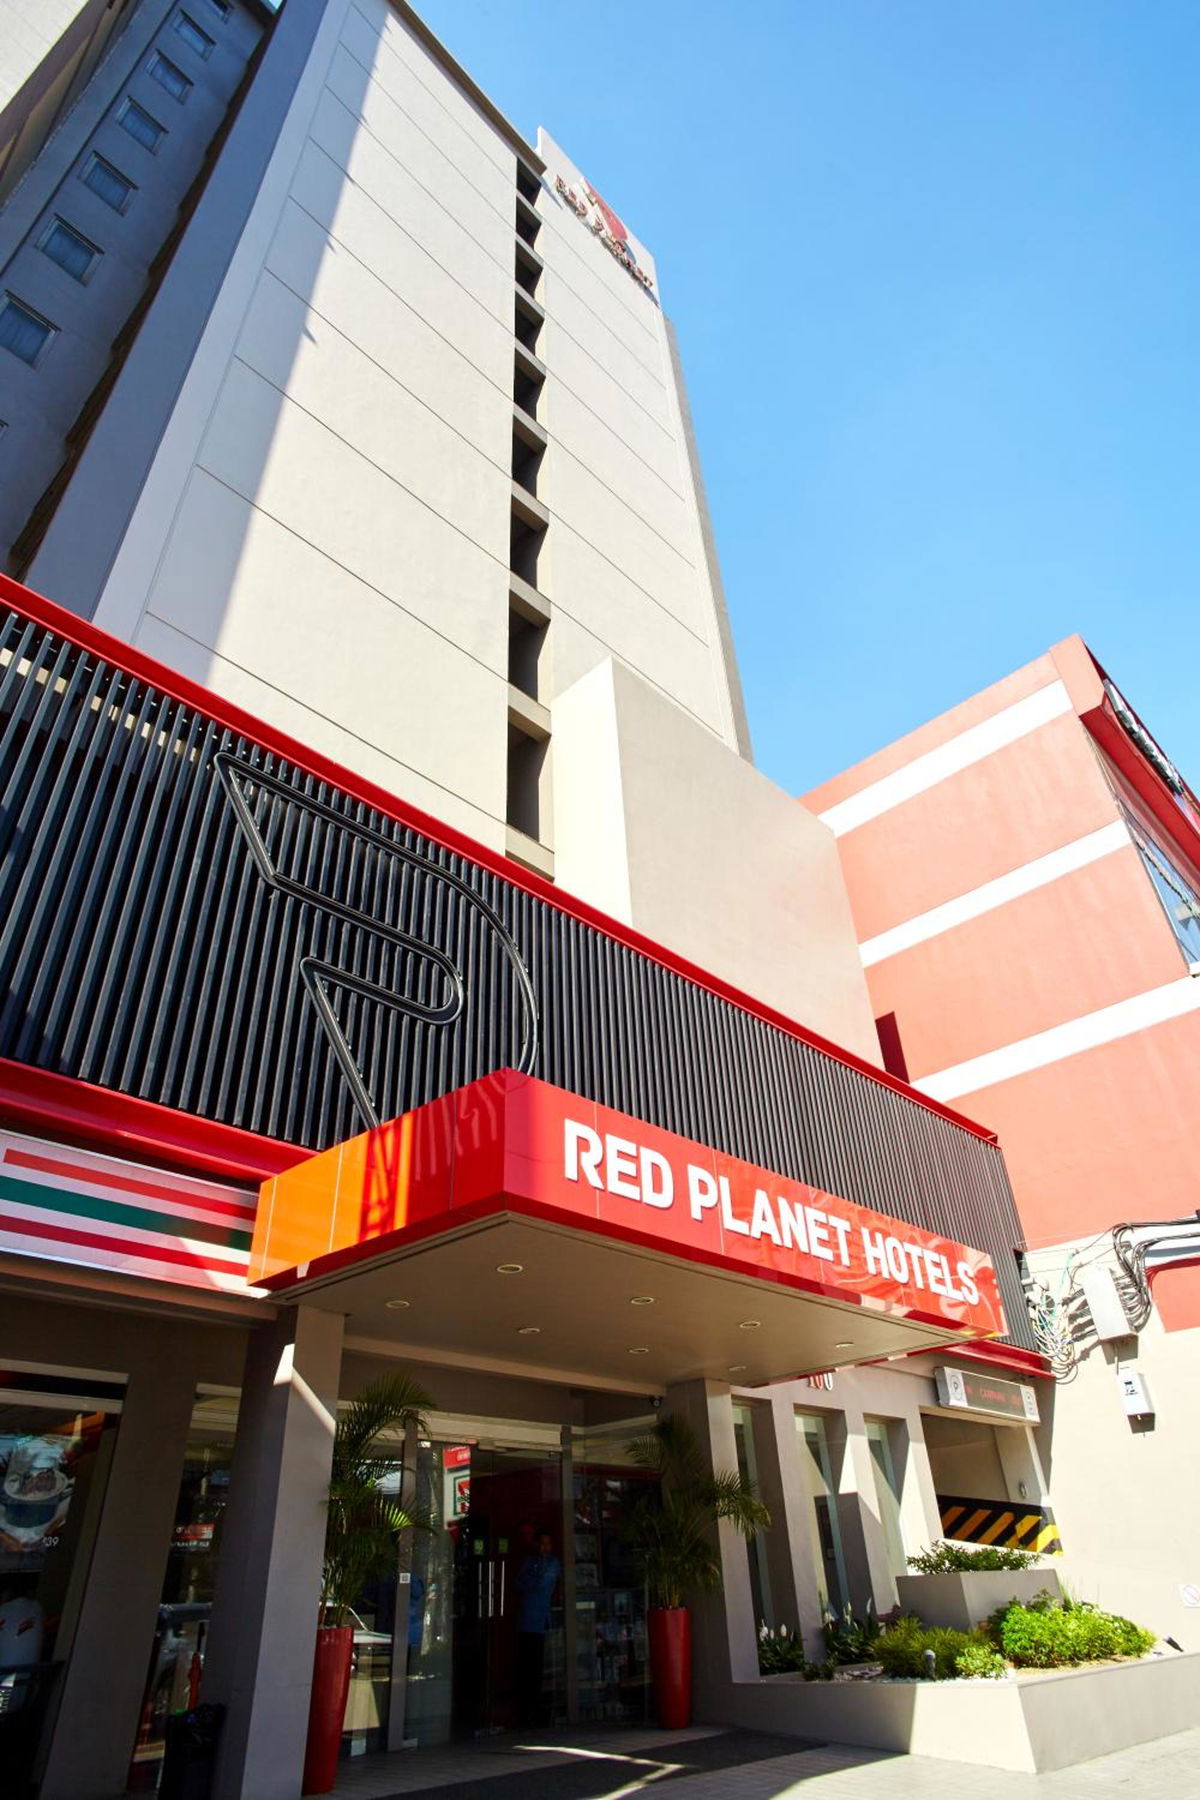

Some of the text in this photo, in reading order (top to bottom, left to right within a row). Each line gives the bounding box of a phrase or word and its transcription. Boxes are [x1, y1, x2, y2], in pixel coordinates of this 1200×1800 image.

[563, 1118, 979, 1306] RED PLANET HOTELS
